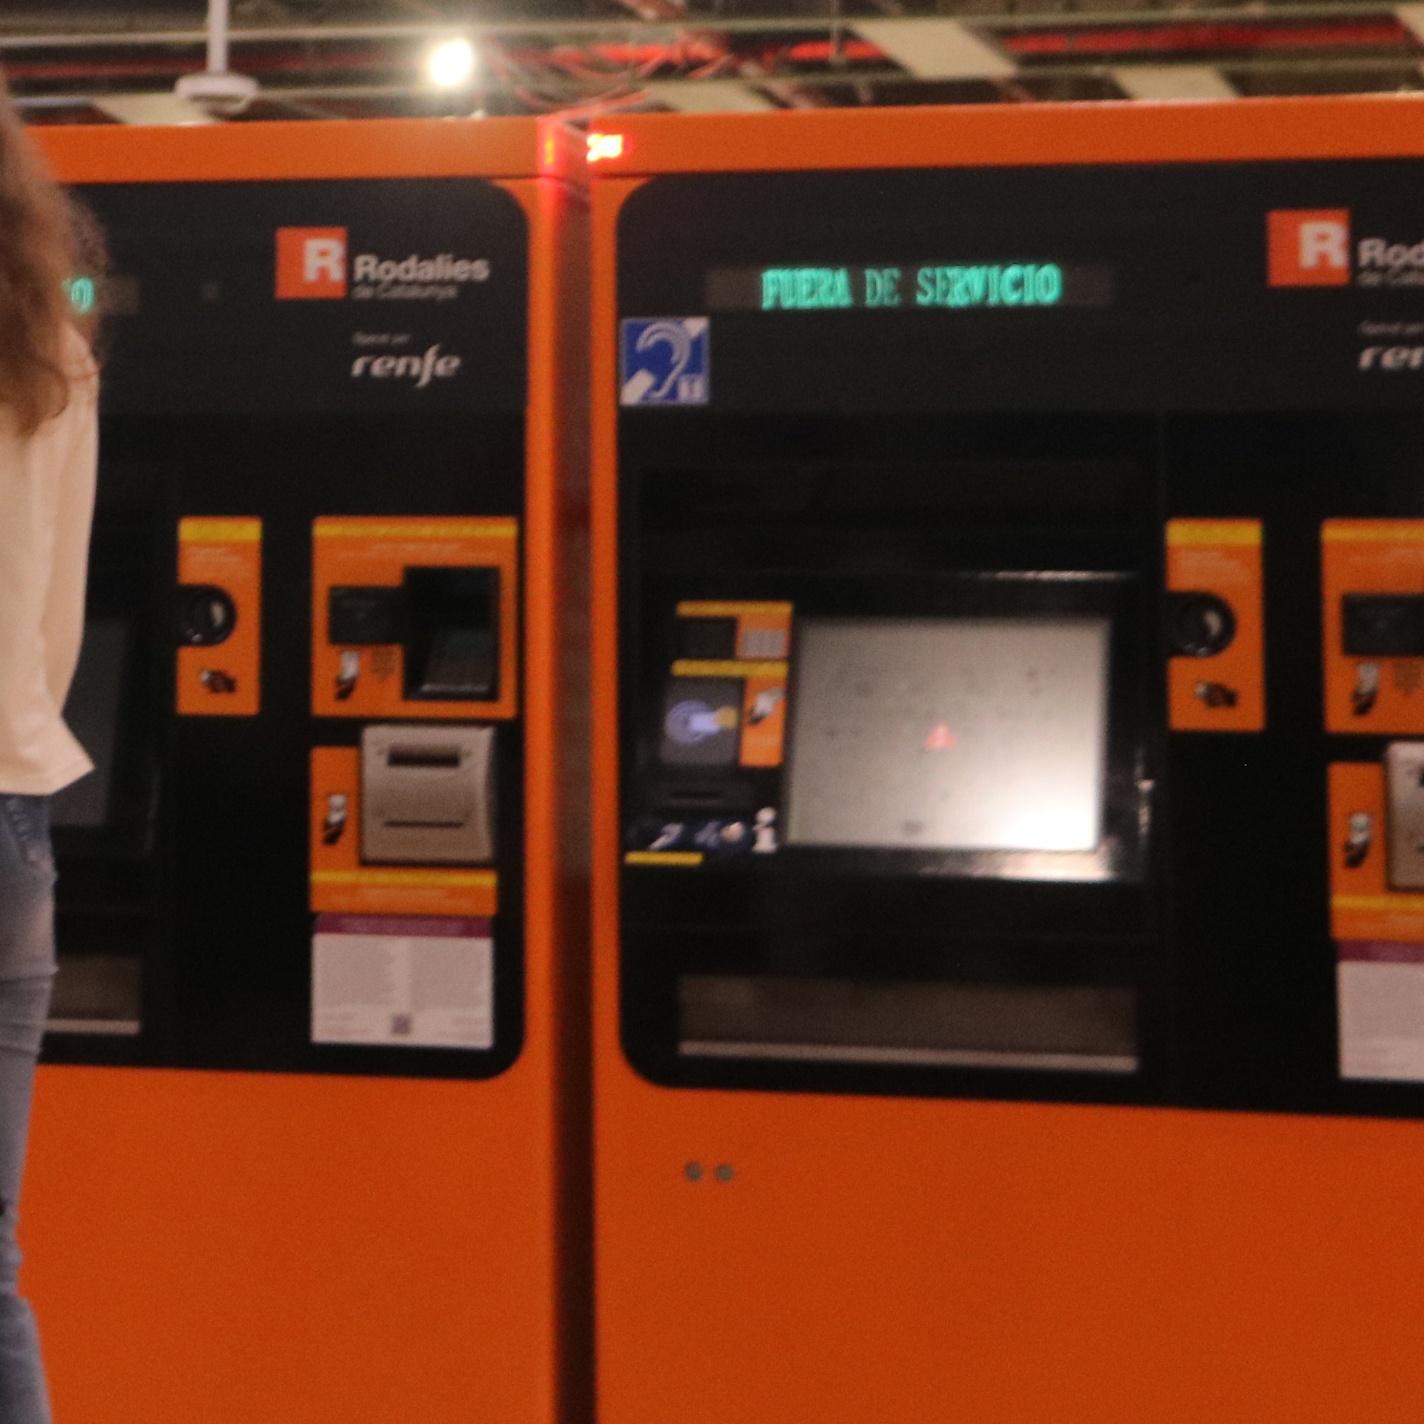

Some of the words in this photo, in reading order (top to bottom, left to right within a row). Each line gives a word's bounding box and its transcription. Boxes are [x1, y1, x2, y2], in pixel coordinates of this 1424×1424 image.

[304, 239, 345, 282] R
[1300, 222, 1349, 269] R
[355, 254, 490, 283] Rodalies
[761, 267, 853, 309] FUERA
[864, 267, 900, 306] DE
[916, 264, 1062, 307] SERVICIO
[352, 344, 461, 388] renfe
